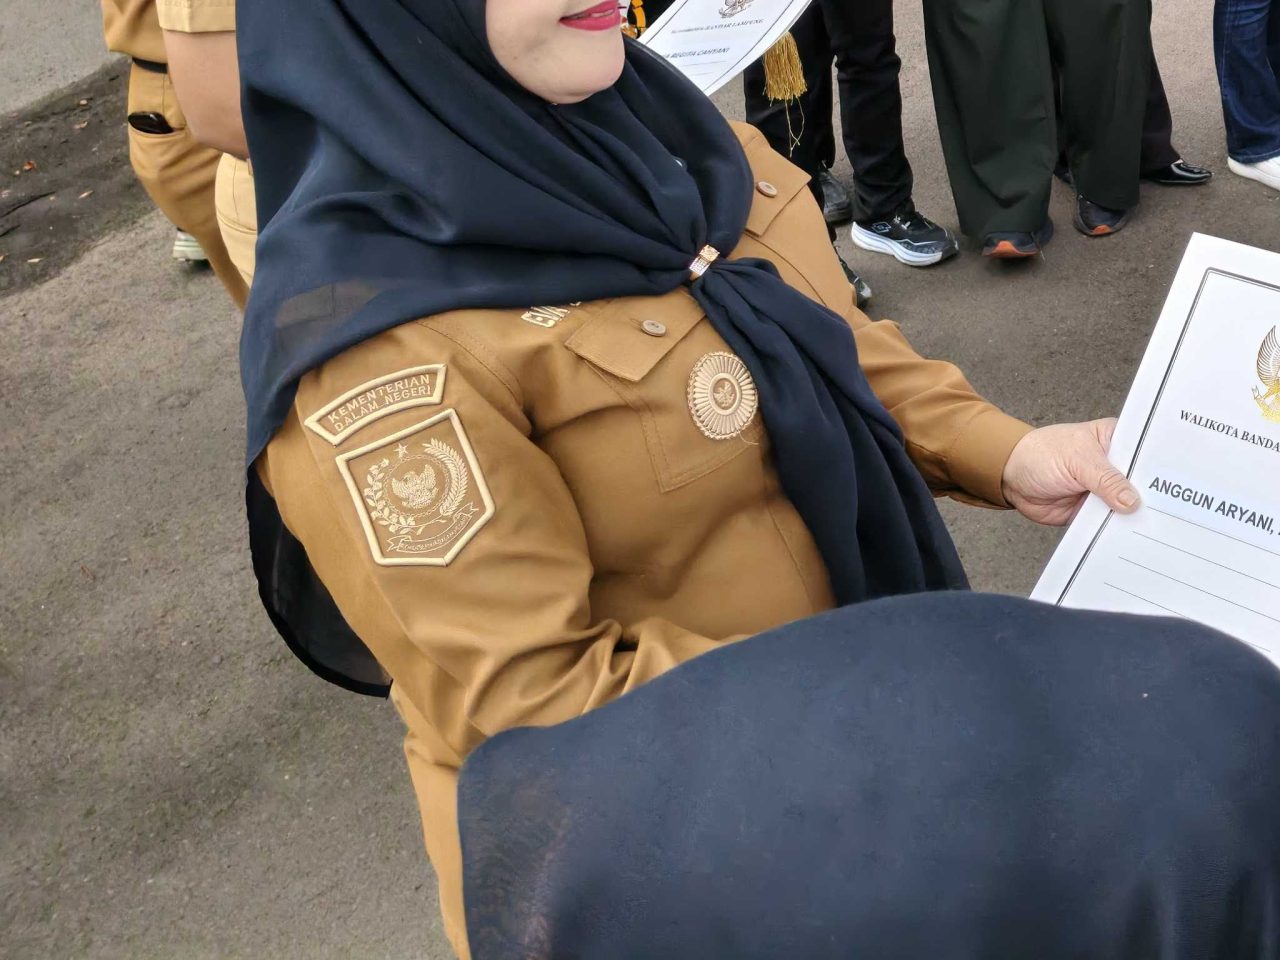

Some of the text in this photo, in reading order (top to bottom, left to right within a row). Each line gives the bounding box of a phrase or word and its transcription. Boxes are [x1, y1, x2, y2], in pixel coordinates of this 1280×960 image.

[327, 374, 430, 424] KEMENTERIAN
[333, 385, 432, 432] DALAM NEGERI
[1179, 409, 1239, 439] WALIKOTA
[1148, 476, 1215, 511] ANGGUN
[1214, 500, 1275, 535] ARYANI,
